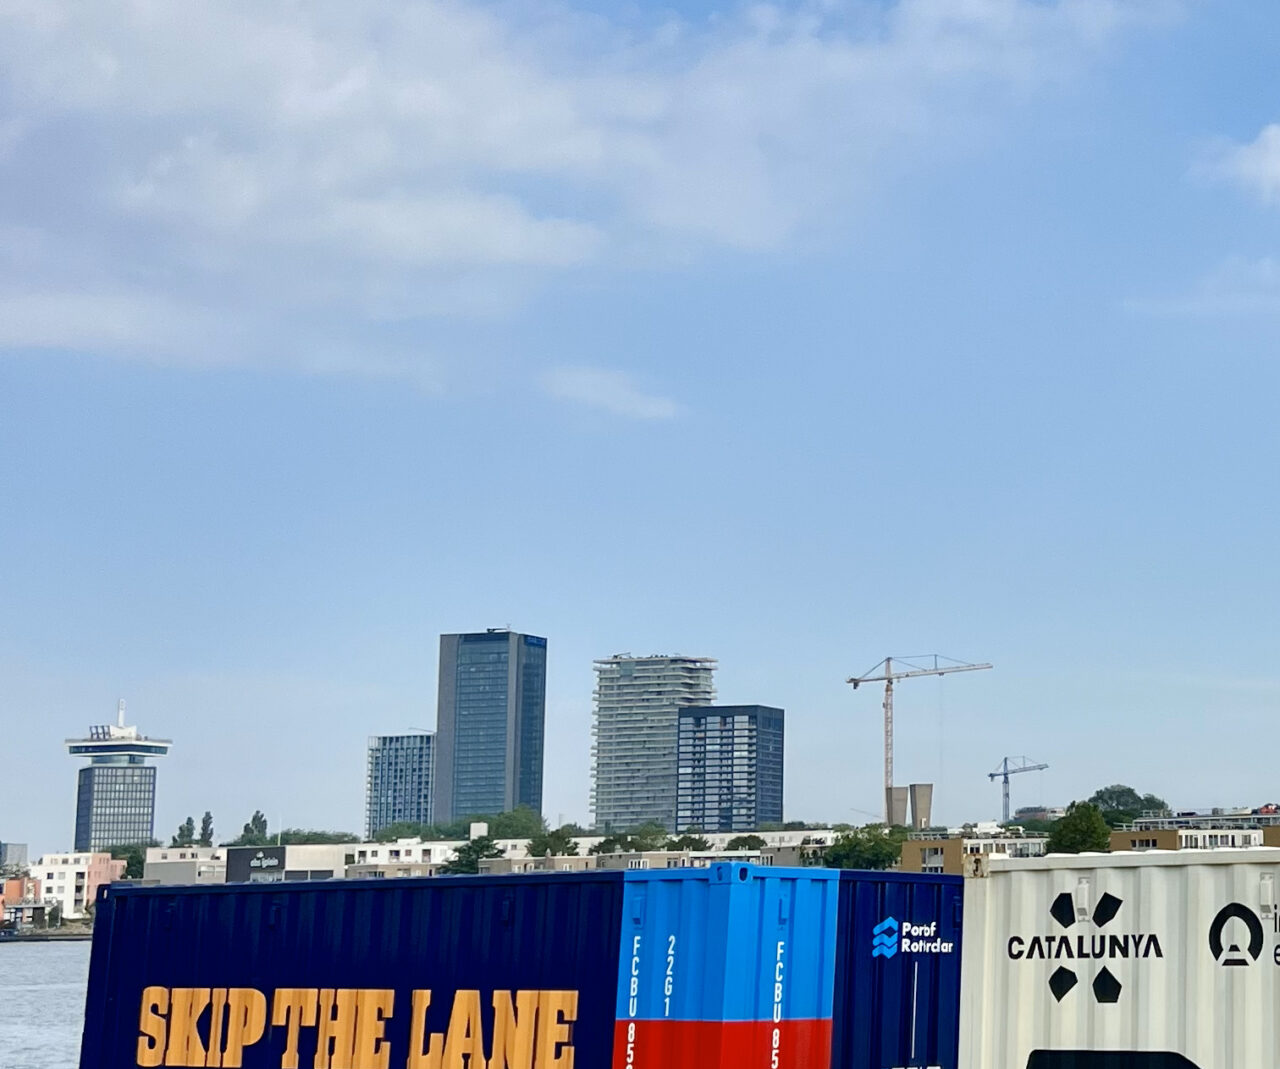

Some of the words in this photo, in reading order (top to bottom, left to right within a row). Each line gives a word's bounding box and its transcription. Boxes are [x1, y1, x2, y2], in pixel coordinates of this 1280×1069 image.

[629, 935, 641, 1018] FCBU
[664, 935, 675, 1017] 22G1
[773, 941, 785, 1023] FCBU
[1007, 933, 1164, 960] CATALUNYA
[136, 986, 266, 1068] SKIP
